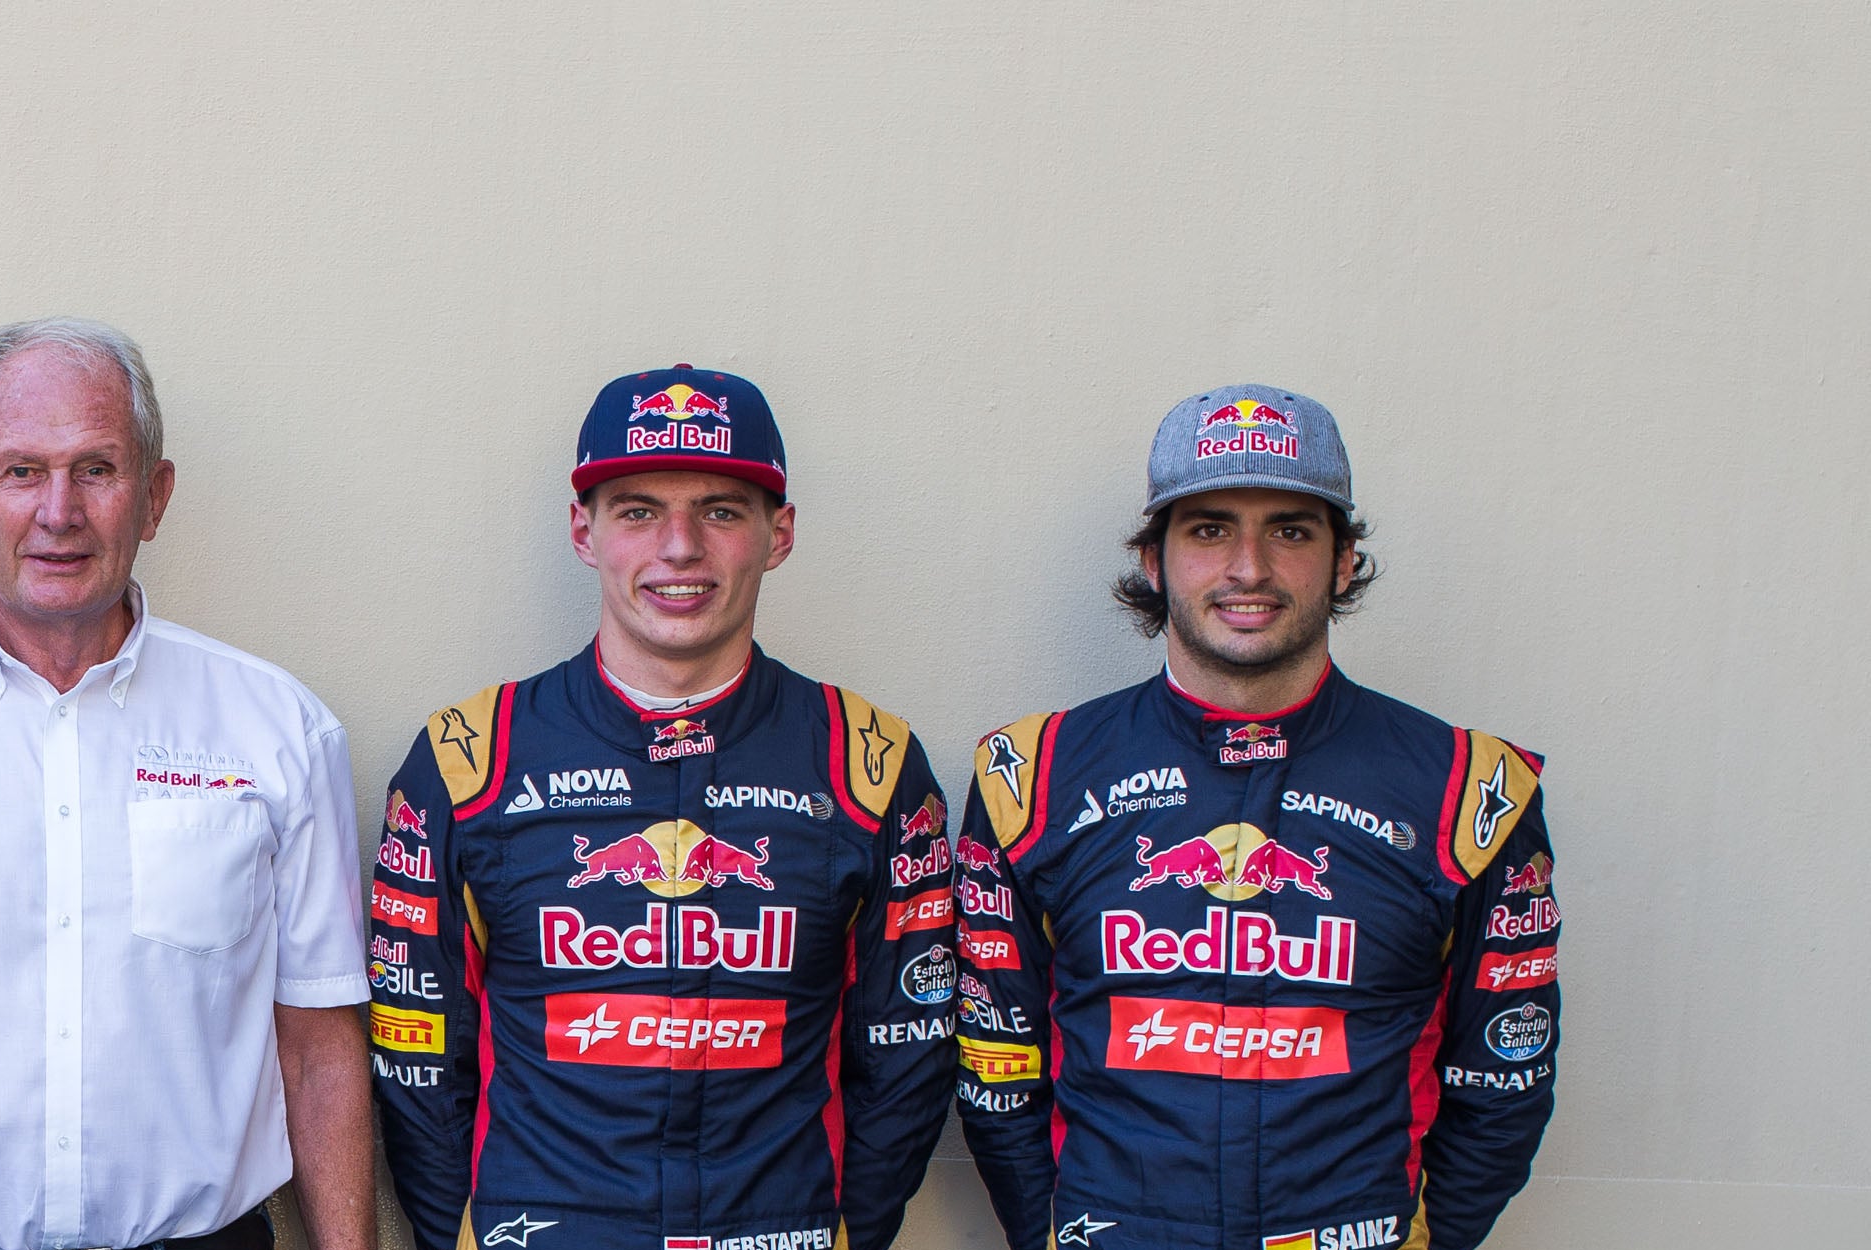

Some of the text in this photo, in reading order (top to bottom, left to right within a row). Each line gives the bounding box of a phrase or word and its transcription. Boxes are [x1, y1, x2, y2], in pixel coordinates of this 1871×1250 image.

[627, 422, 731, 454] Red Bull
[1196, 430, 1299, 460] Red Bull
[649, 736, 715, 762] Red Bull
[1219, 739, 1287, 763] Red Bull
[136, 768, 201, 787] Red Bull
[549, 768, 631, 795] NOVA
[1108, 767, 1188, 802] NOVA
[549, 793, 632, 808] Chemicals
[704, 785, 814, 817] SAPINDA
[1107, 791, 1187, 817] Chemicals
[1281, 790, 1394, 846] SAPINDA
[891, 840, 938, 888] Red
[964, 879, 1013, 921] Bull
[1485, 898, 1539, 940] Red
[539, 902, 797, 973] Red Bull
[1101, 906, 1356, 986] Red Bull
[627, 1016, 767, 1049] CEPSA
[1184, 1022, 1323, 1059] CEPSA
